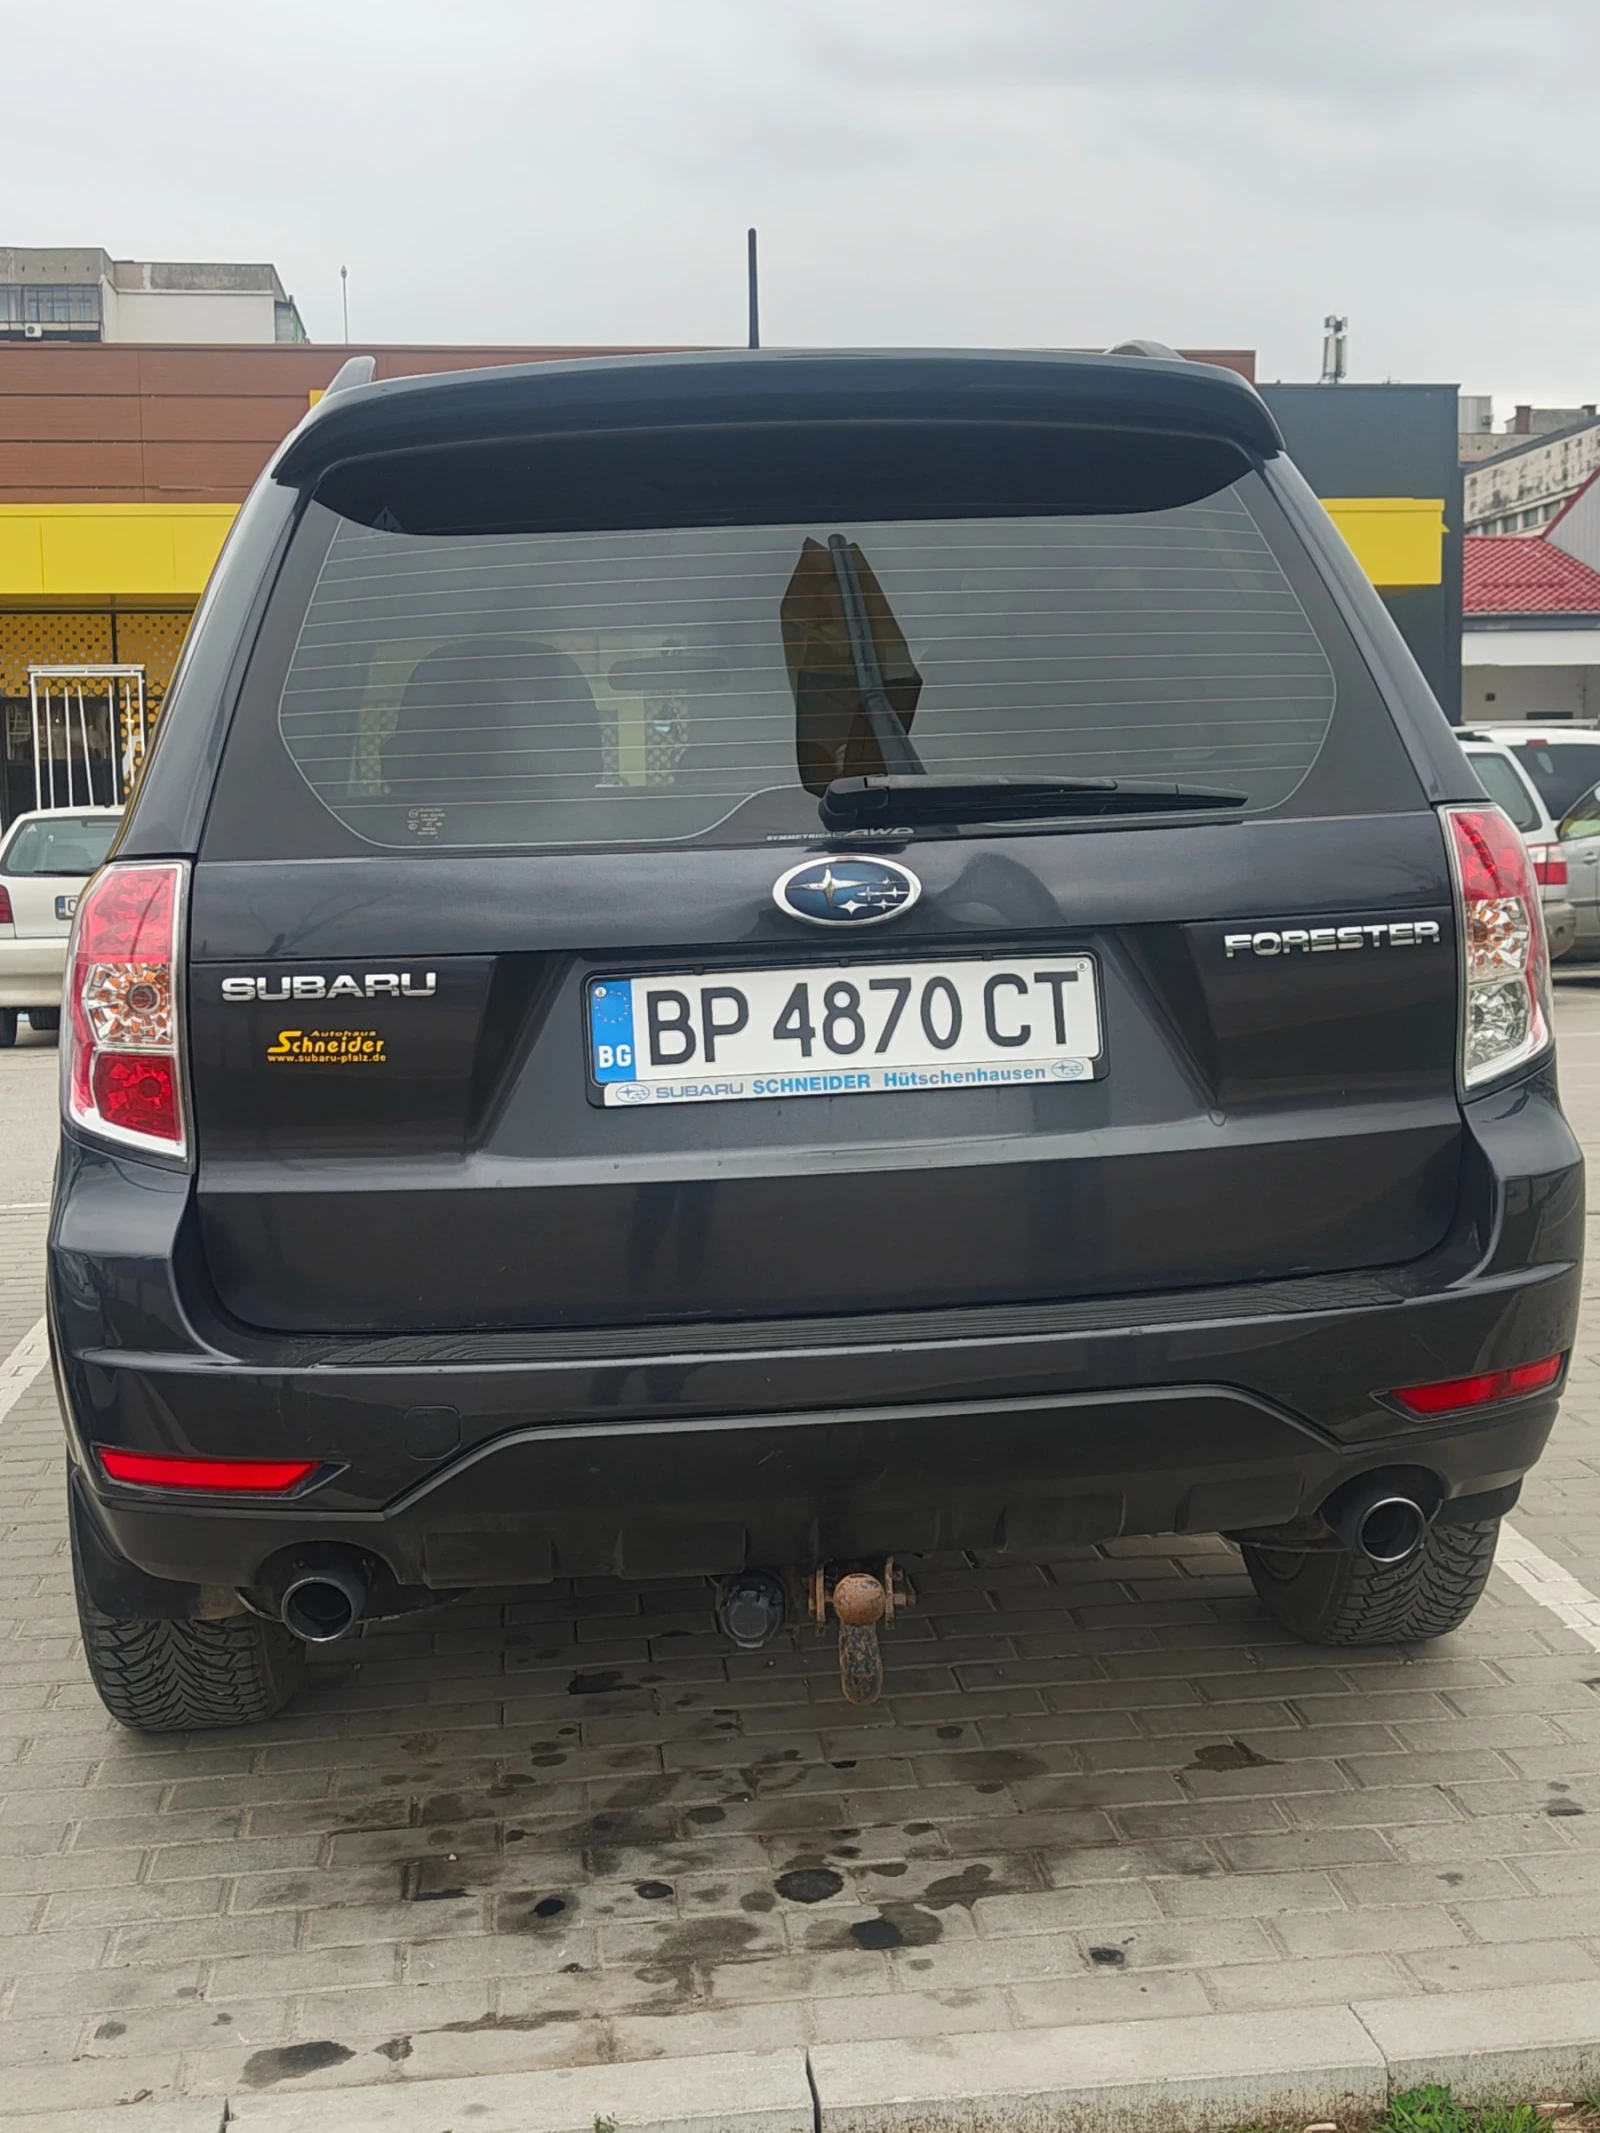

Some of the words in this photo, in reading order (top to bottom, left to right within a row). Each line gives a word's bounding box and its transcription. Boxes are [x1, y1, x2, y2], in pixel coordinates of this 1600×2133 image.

[767, 832, 836, 841] SYMMETRICAL
[844, 827, 915, 837] AWD
[1224, 921, 1440, 957] FORESTER
[221, 972, 436, 1001] SUBARU
[646, 986, 749, 1067] BP
[773, 975, 963, 1058] 4870
[983, 971, 1079, 1048] CT
[267, 1030, 385, 1053] Schneider
[267, 1053, 387, 1064] www.subaru-pfalz.de
[599, 1044, 632, 1068] BG
[655, 1082, 744, 1099] SUBARU
[752, 1073, 871, 1095] SCHNEIDER
[883, 1067, 1046, 1088] Hütschenhausen
